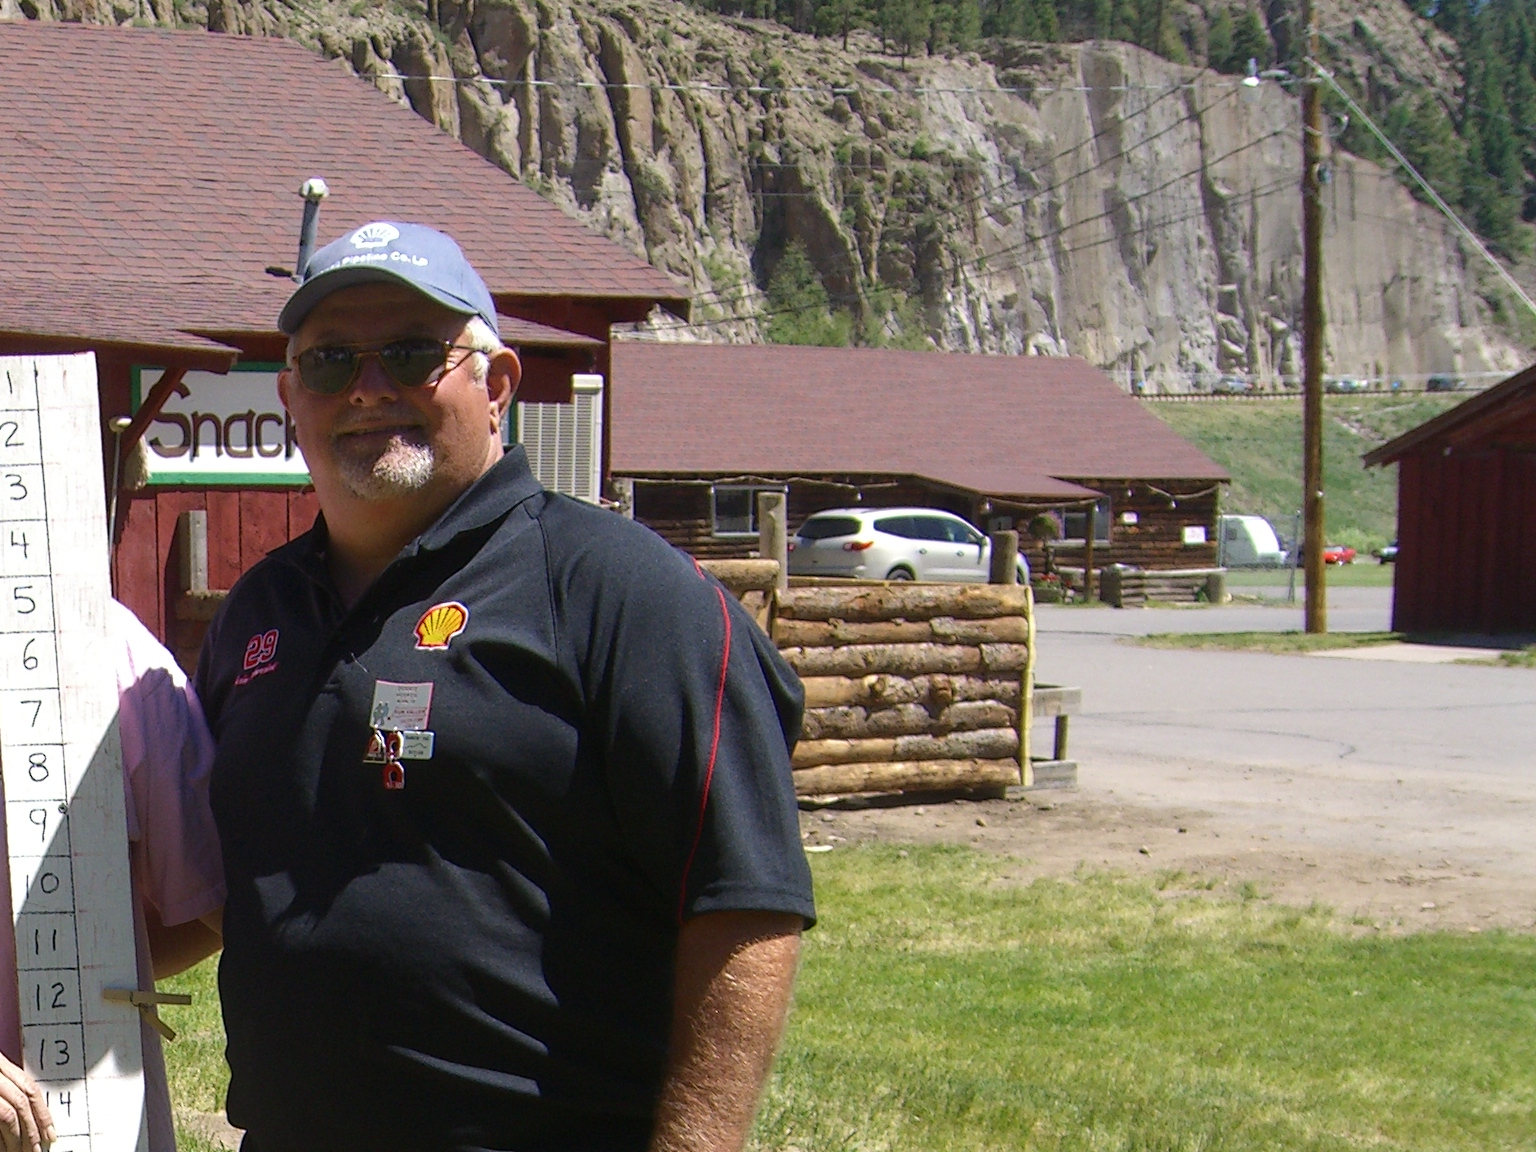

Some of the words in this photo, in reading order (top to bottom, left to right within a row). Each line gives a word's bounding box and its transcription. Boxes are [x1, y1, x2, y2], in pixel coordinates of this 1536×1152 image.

[6, 369, 13, 395] 1
[4, 474, 28, 501] 3
[10, 530, 30, 559] 4
[13, 585, 36, 615] 5
[22, 637, 39, 671] 6
[243, 629, 280, 671] 29
[19, 699, 43, 728] 7
[27, 752, 49, 782] 8
[28, 808, 48, 843] 9
[25, 871, 60, 900] 10
[34, 928, 58, 956] 11
[35, 982, 67, 1012] 12
[39, 1038, 70, 1071] 13
